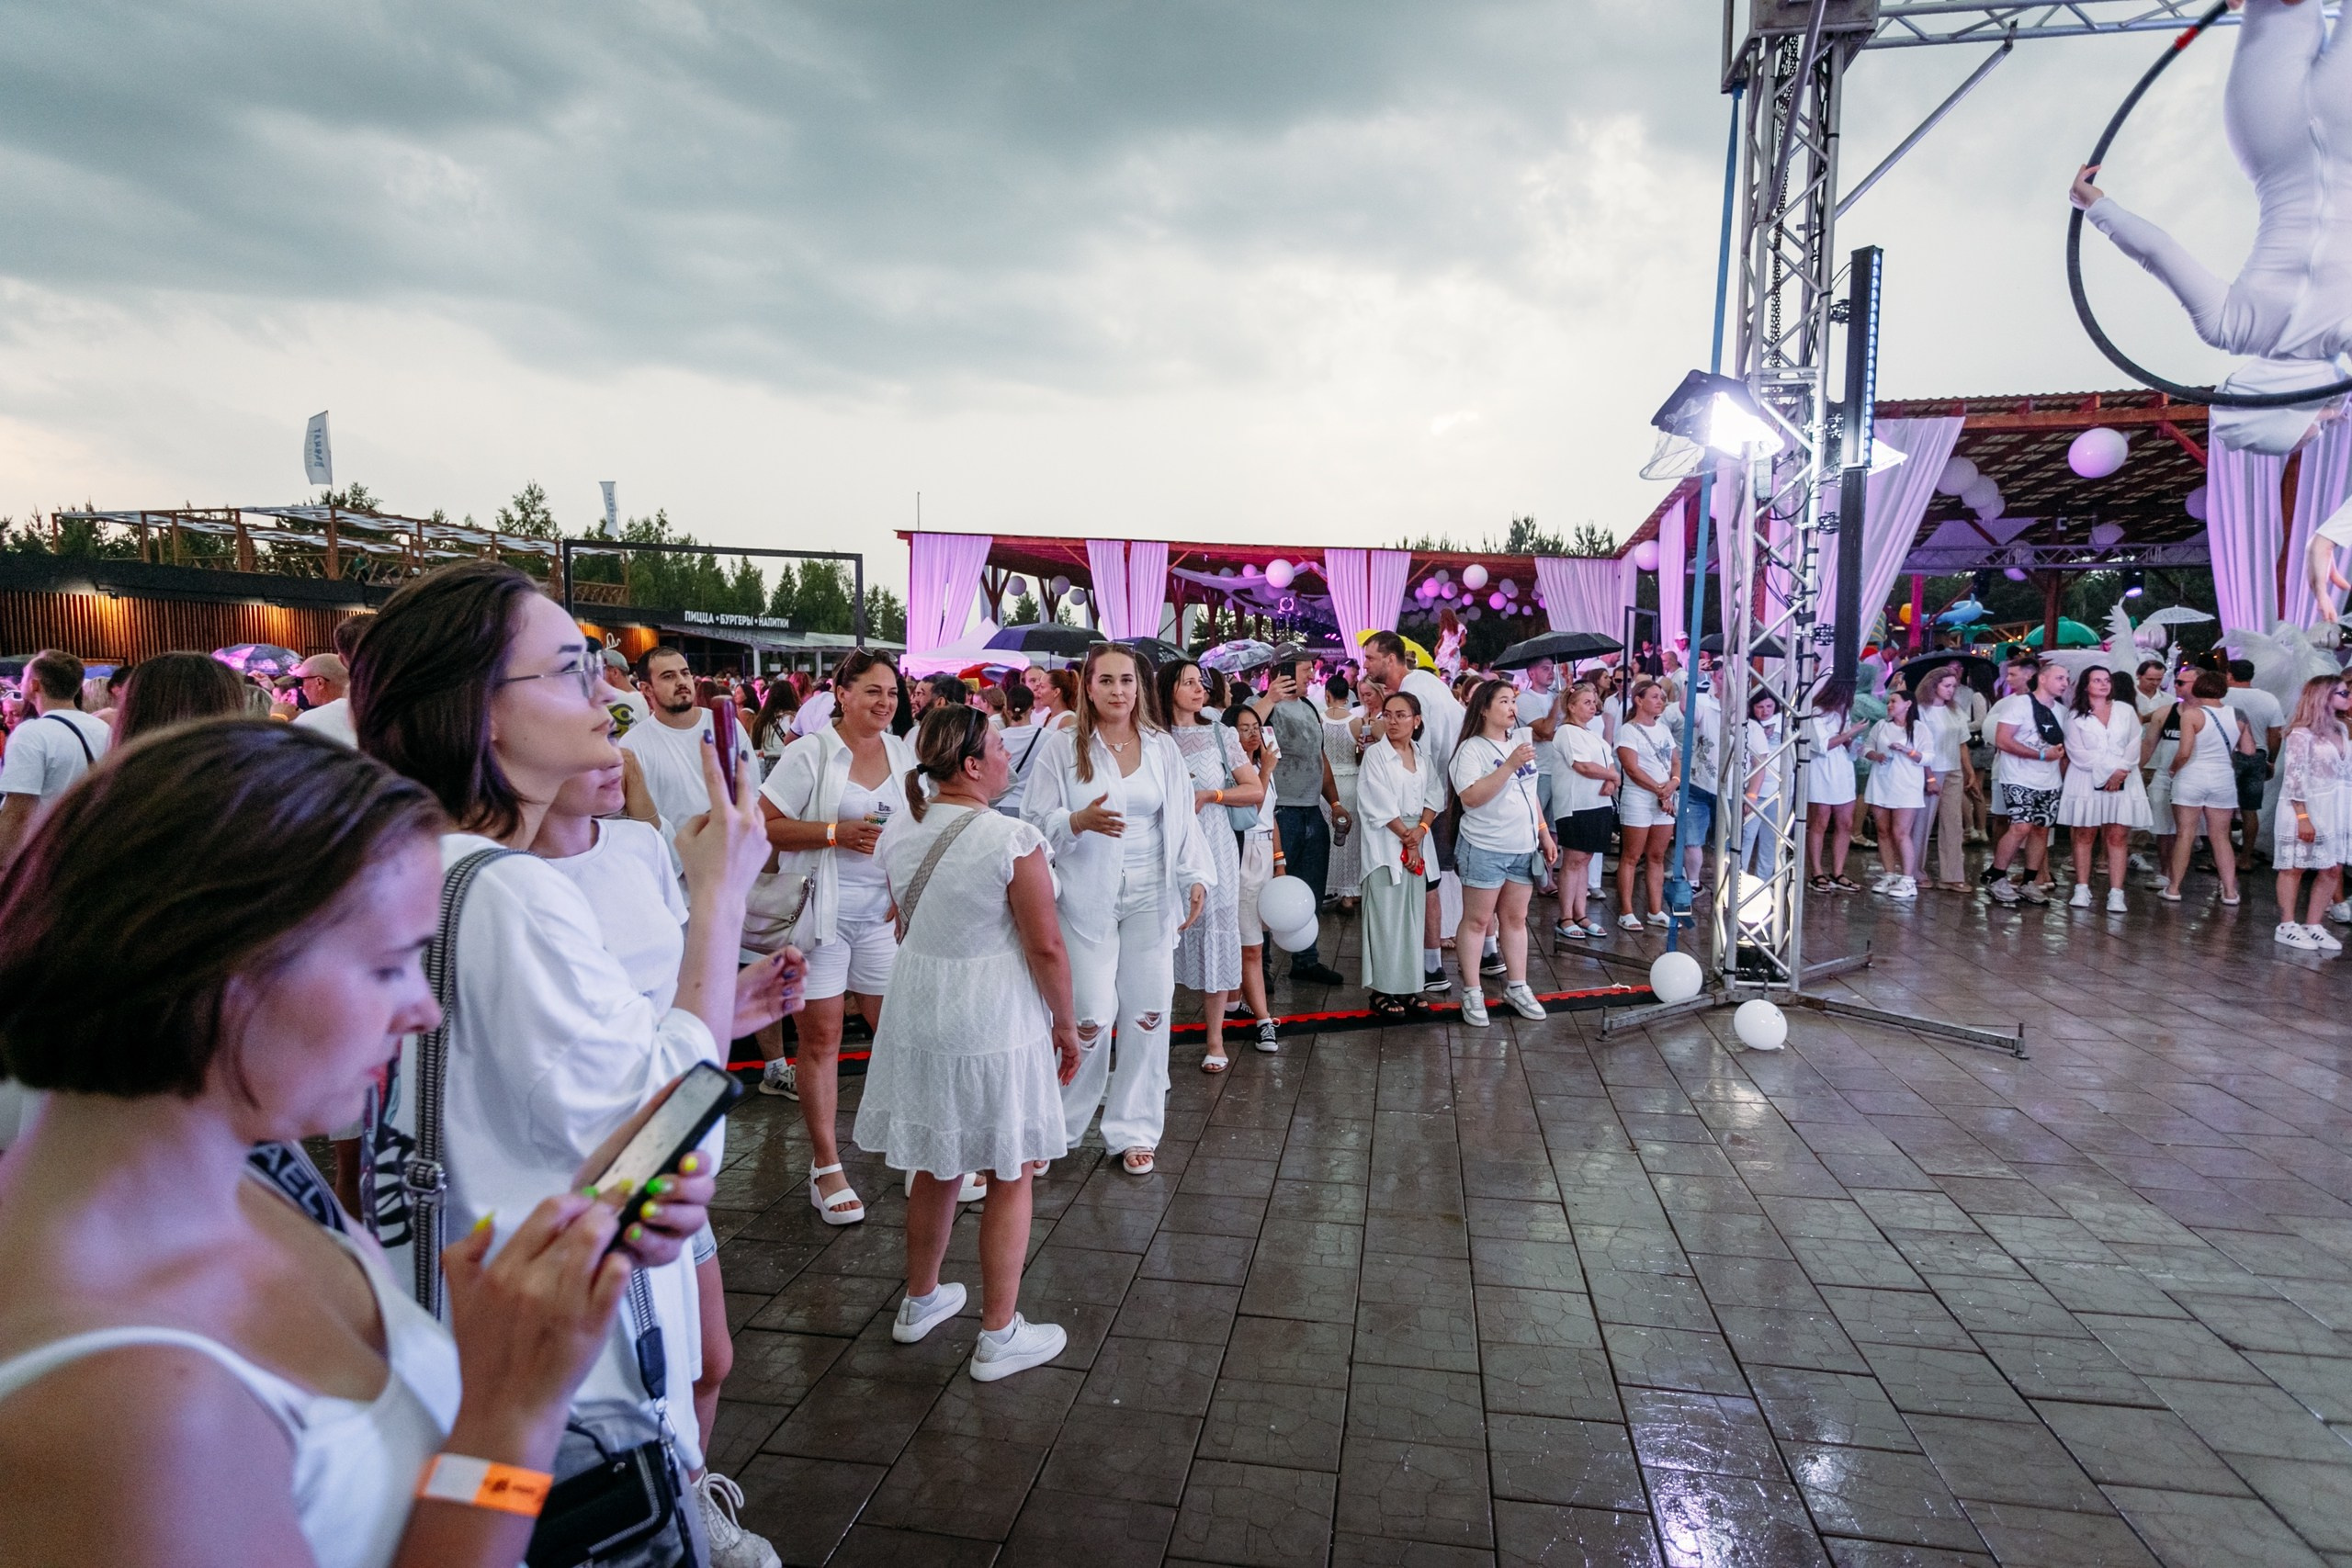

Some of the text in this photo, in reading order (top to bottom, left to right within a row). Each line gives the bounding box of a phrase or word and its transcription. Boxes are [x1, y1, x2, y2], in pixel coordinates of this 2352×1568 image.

[684, 610, 789, 628] ПИЦЦА БУРГЕРЫ НАПИТКИ
